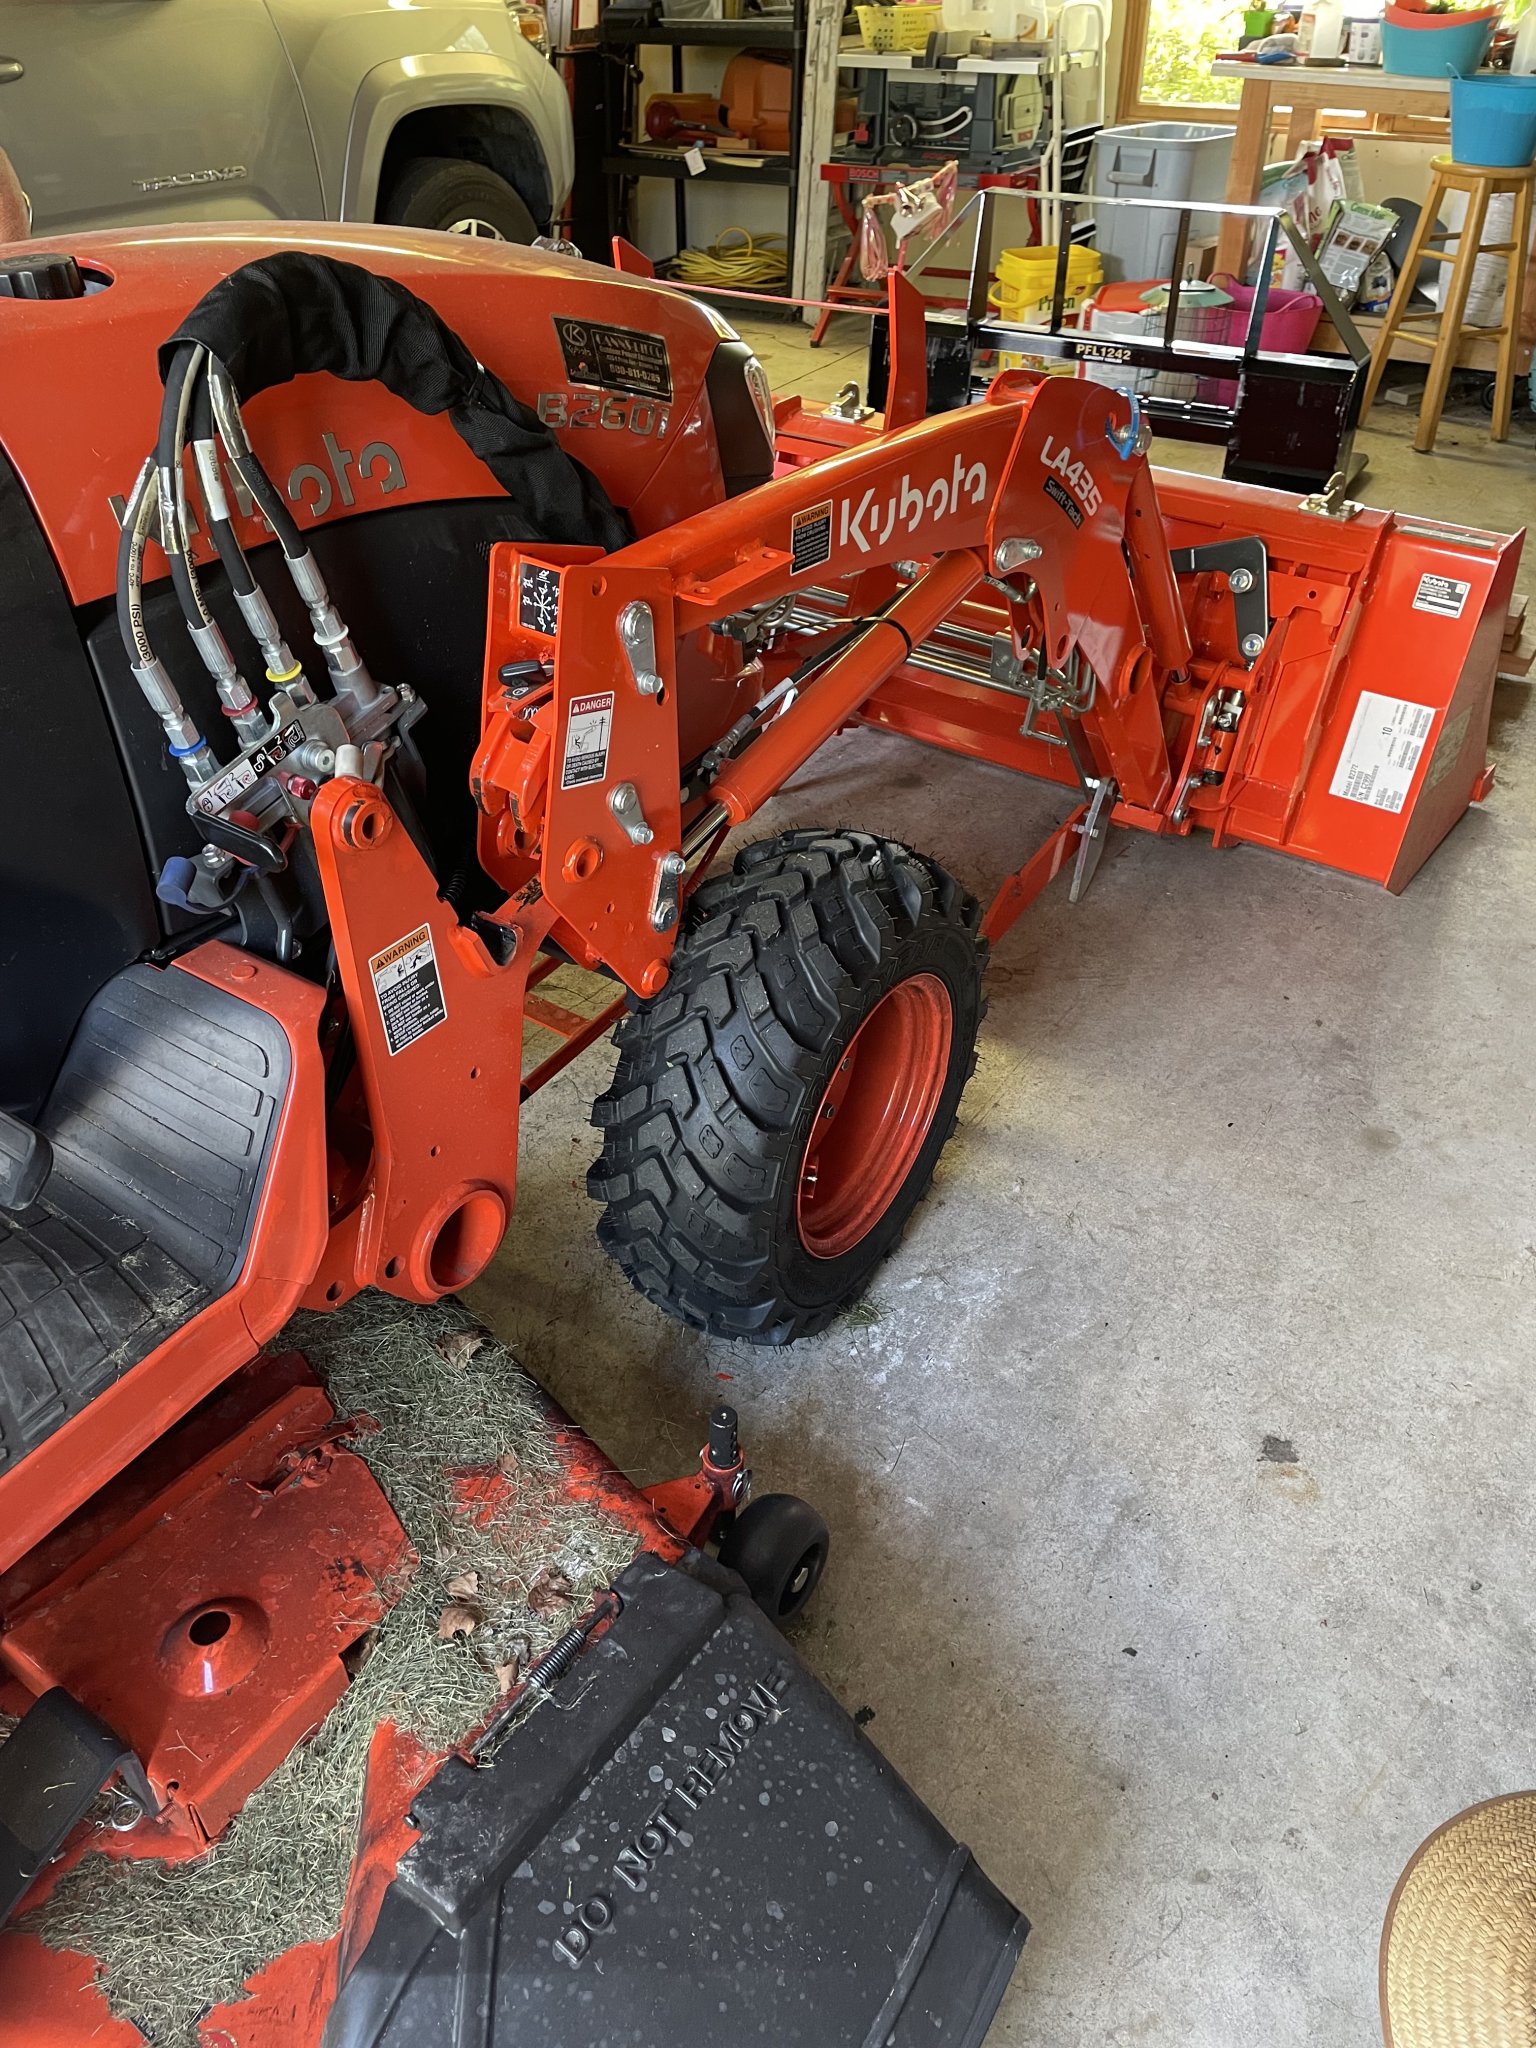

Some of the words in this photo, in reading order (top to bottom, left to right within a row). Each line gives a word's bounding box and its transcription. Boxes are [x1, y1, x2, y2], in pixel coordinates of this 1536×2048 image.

[1075, 344, 1131, 361] PFL1242
[537, 393, 670, 440] B2601
[1040, 435, 1103, 517] LA435
[840, 453, 987, 553] Kubota
[131, 603, 143, 628] PSI)
[135, 630, 152, 662] (3000
[580, 698, 612, 712] DANGER
[1381, 726, 1392, 736] 10
[383, 931, 426, 963] WARNING
[554, 1898, 613, 1964] DO
[613, 1802, 681, 1890] NOT
[675, 1668, 790, 1811] REMOVE
